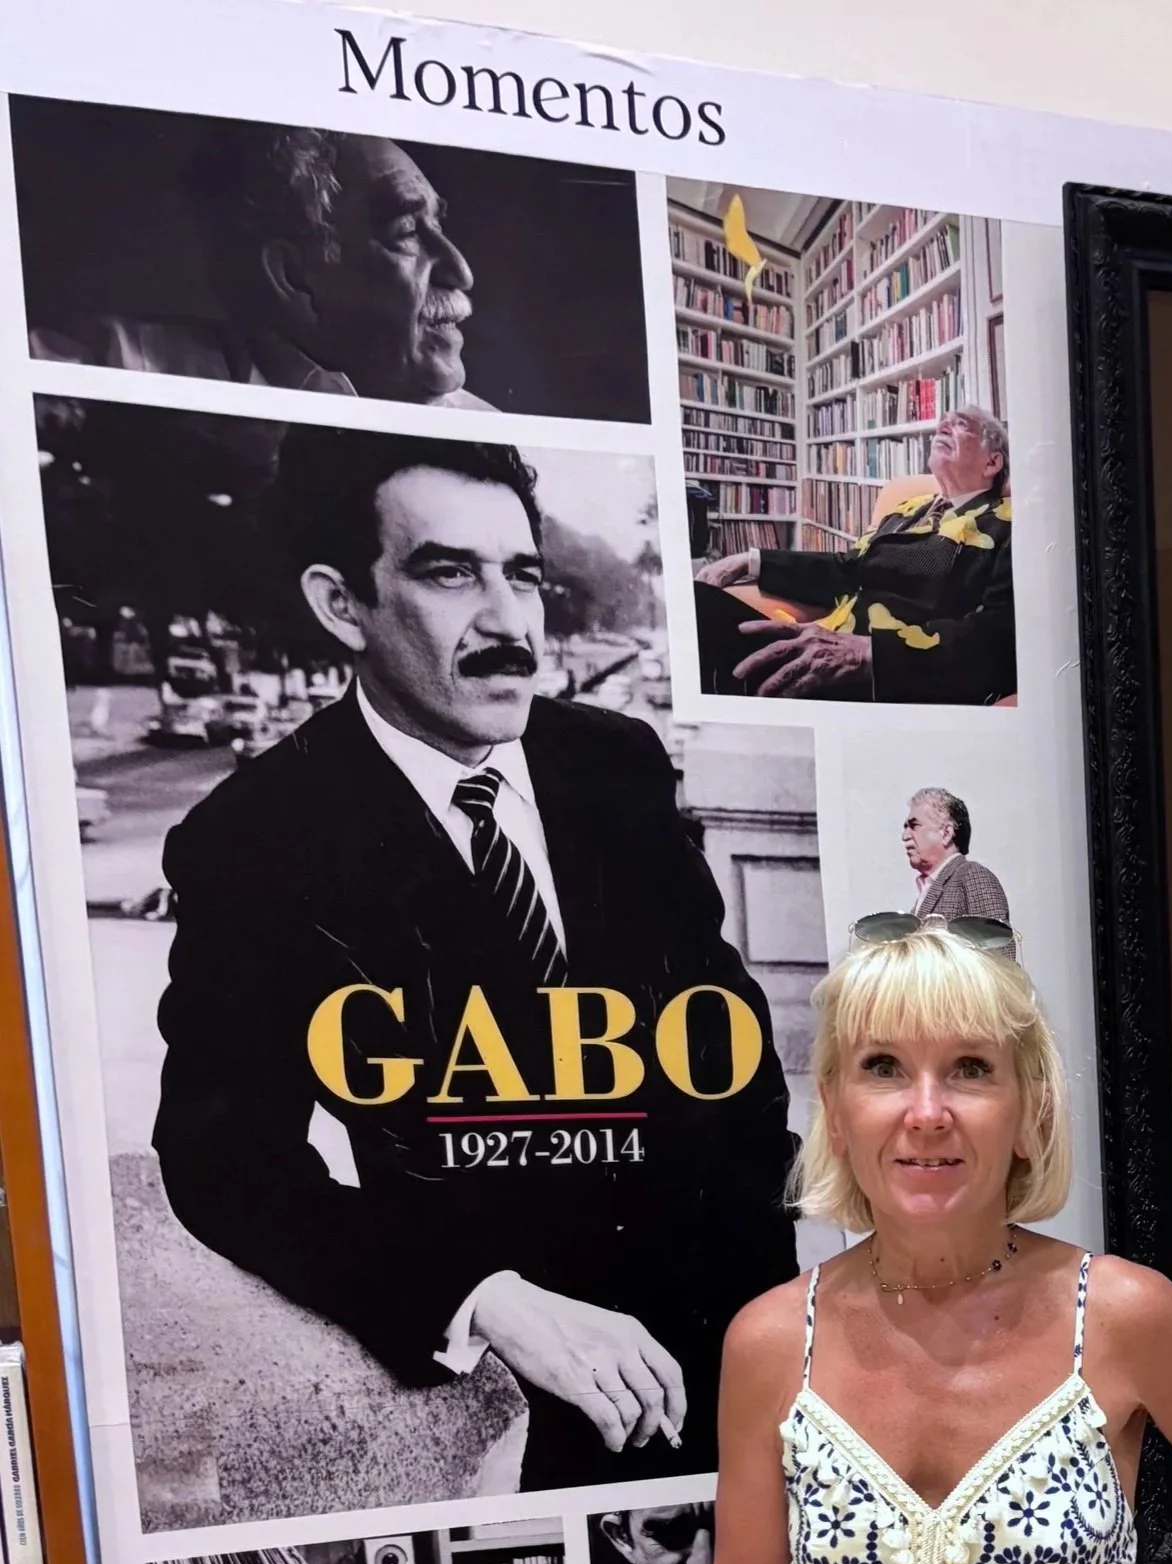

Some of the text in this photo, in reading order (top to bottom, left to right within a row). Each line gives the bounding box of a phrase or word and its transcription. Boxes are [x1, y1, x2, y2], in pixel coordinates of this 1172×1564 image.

[334, 28, 726, 146] Momentos
[307, 983, 763, 1105] GABO
[439, 1128, 646, 1167] 1927-2014
